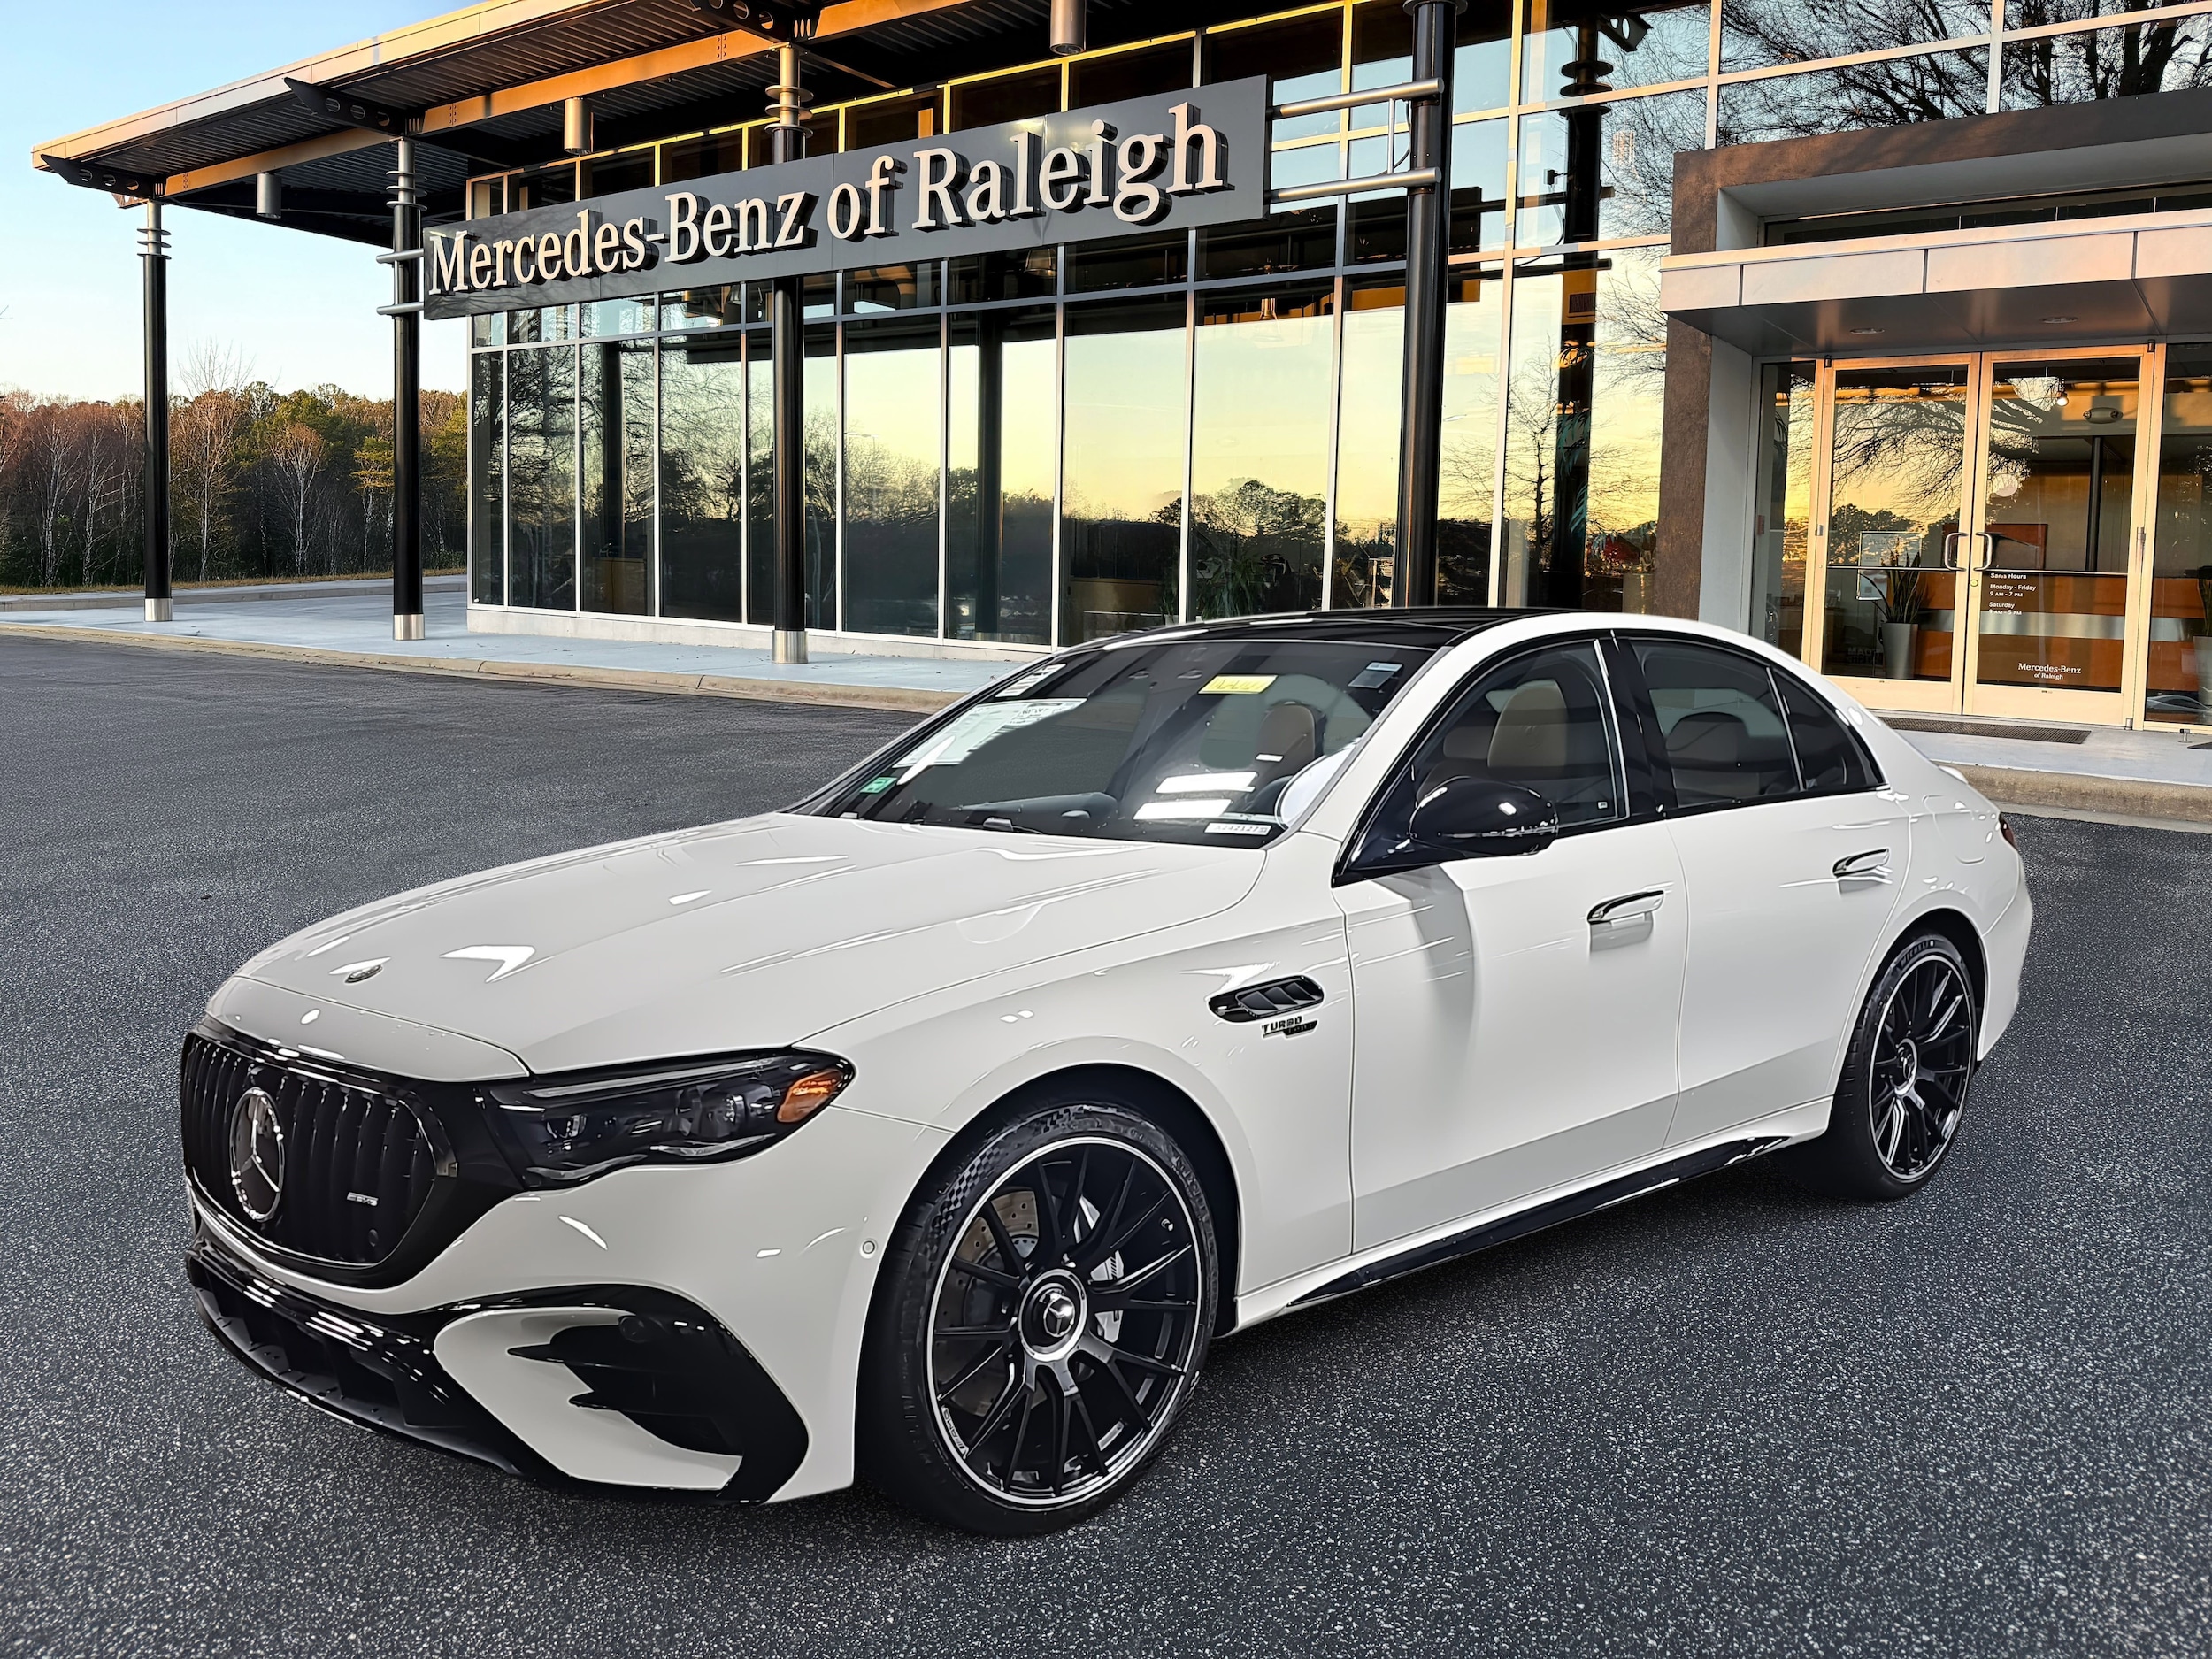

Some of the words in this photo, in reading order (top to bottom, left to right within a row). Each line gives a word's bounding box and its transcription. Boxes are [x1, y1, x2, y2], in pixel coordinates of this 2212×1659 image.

[428, 190, 807, 296] Mercedes-Benz
[827, 155, 895, 240] of
[911, 102, 1225, 223] Raleigh
[2017, 662, 2082, 674] Mercedes-Benz
[1261, 1016, 1302, 1034] TURBO
